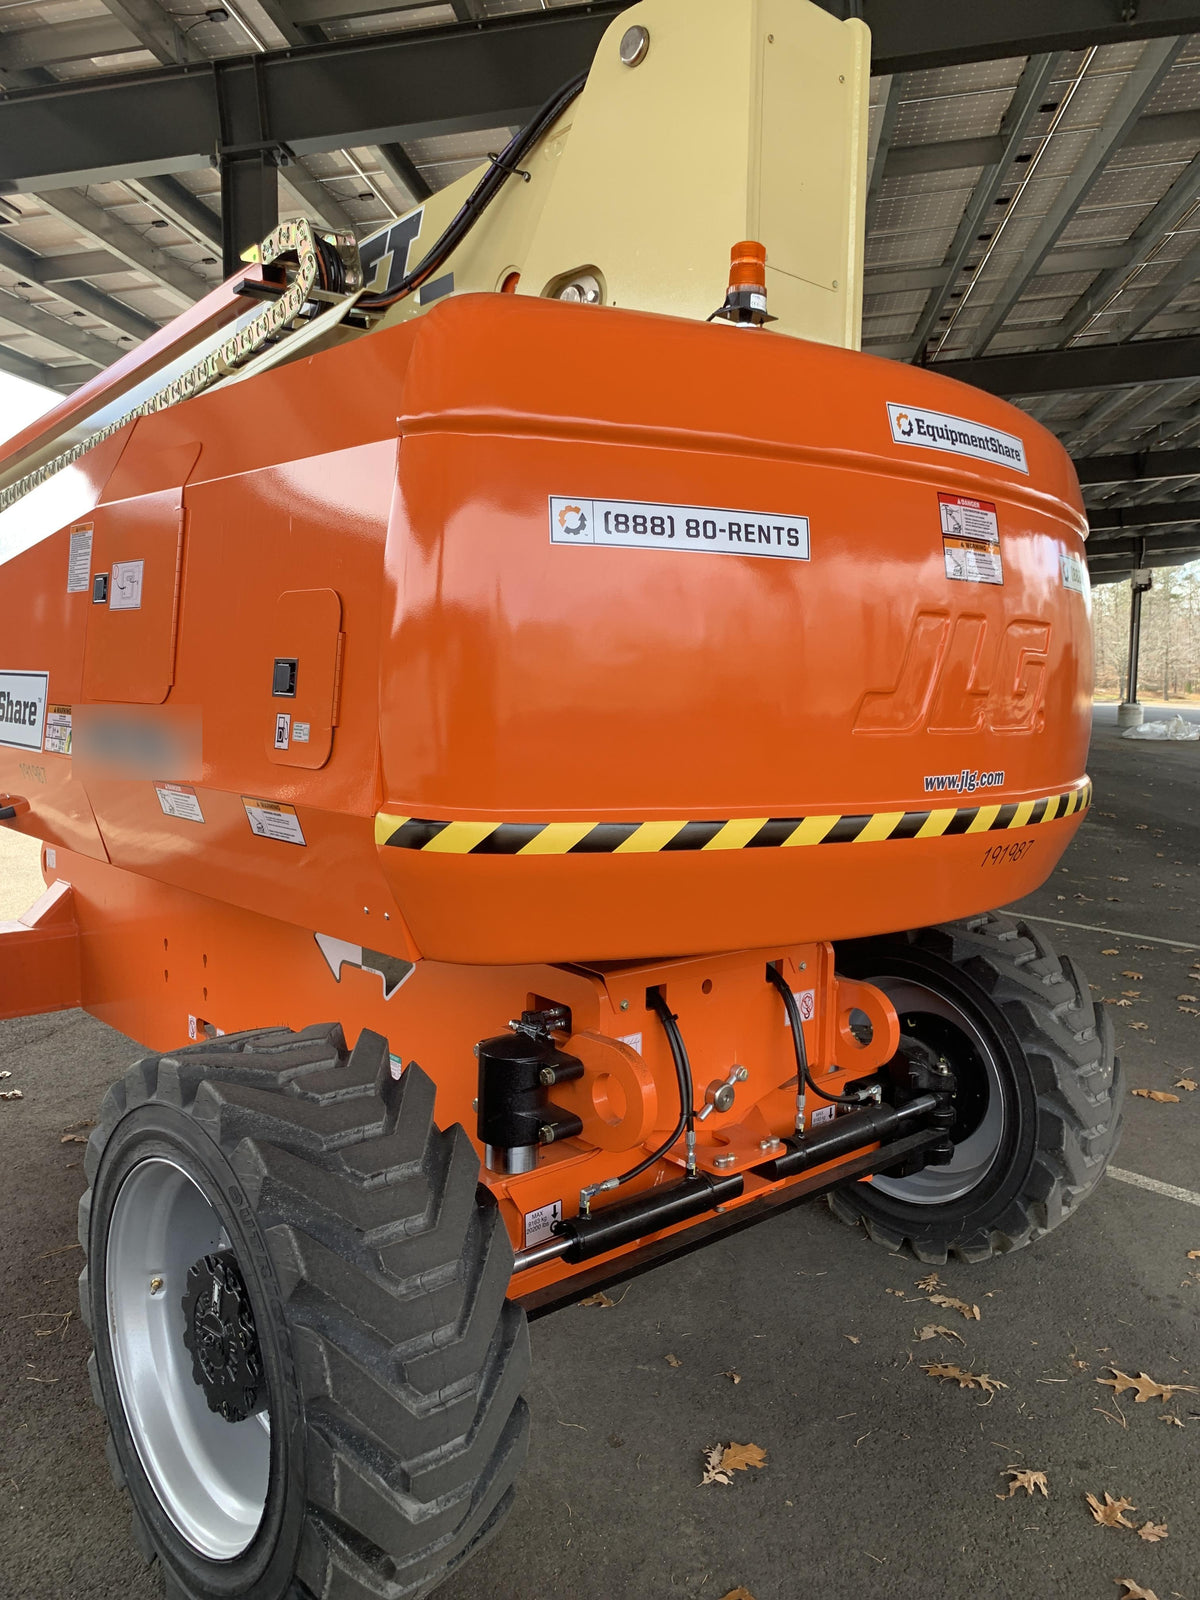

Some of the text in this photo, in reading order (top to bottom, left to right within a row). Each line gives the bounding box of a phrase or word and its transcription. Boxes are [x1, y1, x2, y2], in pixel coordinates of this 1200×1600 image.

[915, 418, 1021, 462] EquipmentShare
[604, 510, 800, 546] (888) 80-RENTS
[852, 610, 1052, 736] JLG
[924, 770, 1004, 792] www.jlg.com
[980, 839, 1035, 867] 191987
